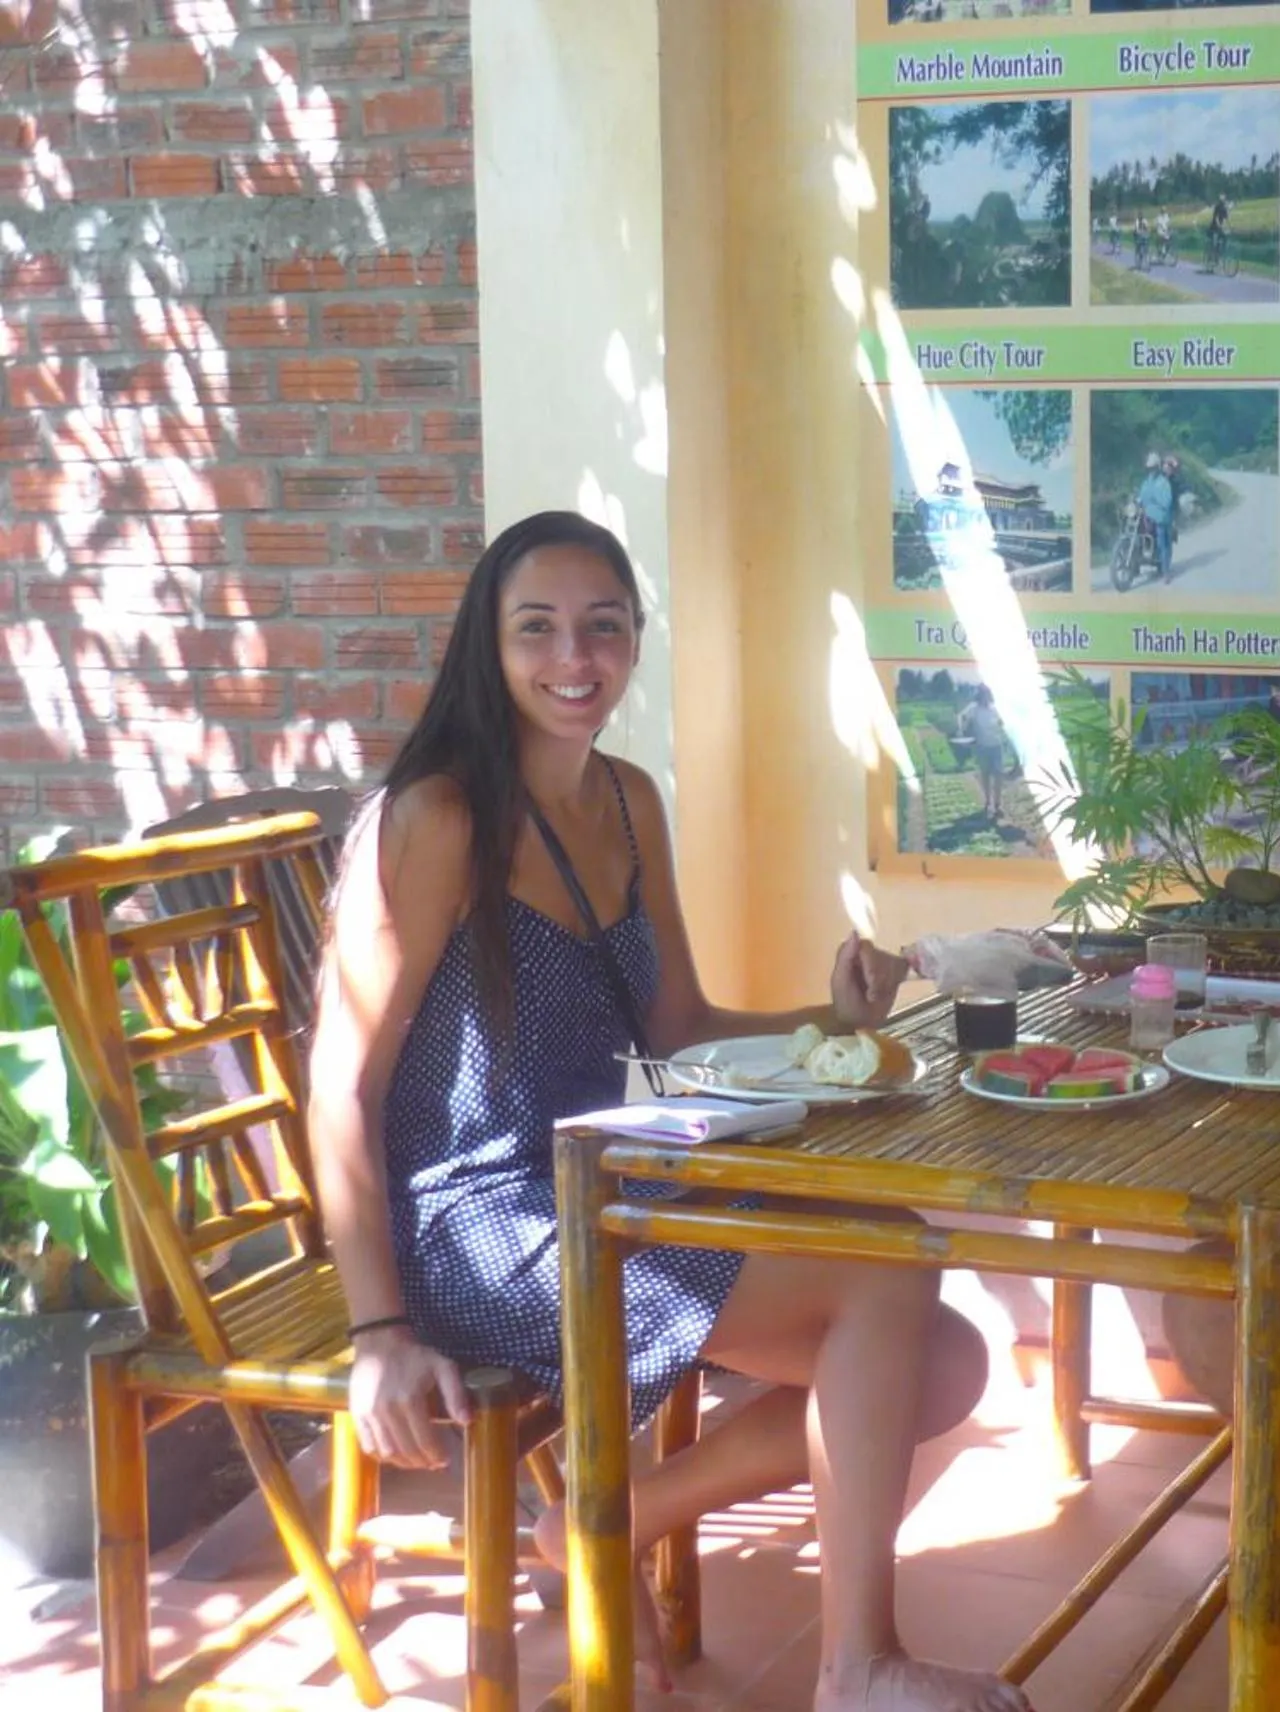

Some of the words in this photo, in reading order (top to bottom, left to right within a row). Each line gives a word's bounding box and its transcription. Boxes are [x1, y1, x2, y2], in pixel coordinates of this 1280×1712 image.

[896, 53, 965, 82] Marble
[971, 49, 1062, 78] Mountain
[1119, 45, 1196, 79] Bicycle
[1203, 43, 1252, 69] Tour
[917, 343, 954, 368] Hue
[959, 342, 997, 374] City
[1003, 343, 1044, 367] Tour
[1133, 341, 1175, 372] Easy
[1181, 339, 1234, 366] Rider
[916, 620, 944, 643] Tra
[1132, 628, 1185, 653] Thanh
[1194, 630, 1218, 654] Ha
